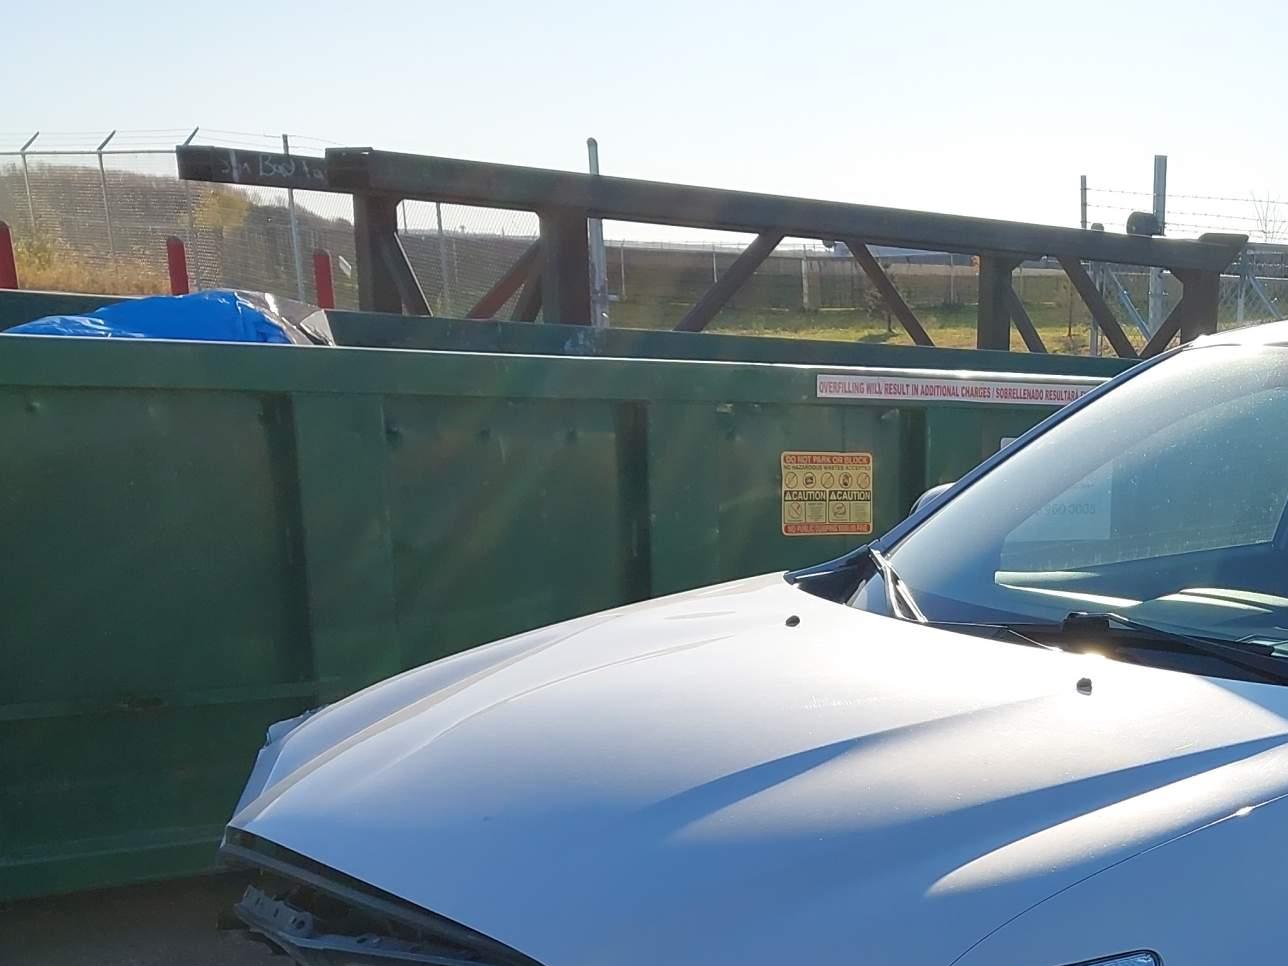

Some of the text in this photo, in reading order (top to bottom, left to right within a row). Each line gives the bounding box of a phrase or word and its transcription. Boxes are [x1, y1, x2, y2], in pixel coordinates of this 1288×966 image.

[819, 381, 865, 393] OVERFILLING
[866, 382, 883, 394] WILL
[884, 383, 910, 395] RESULT
[911, 384, 919, 396] IN
[920, 384, 960, 397] ADDITIONAL
[961, 386, 991, 399] CHARGES
[995, 387, 1044, 400] SOBRELLENADO
[797, 455, 812, 464] NOT
[832, 456, 843, 464] OR
[844, 456, 867, 464] BLOCK
[792, 491, 826, 500] CAUTION
[836, 491, 871, 500] CAUTION
